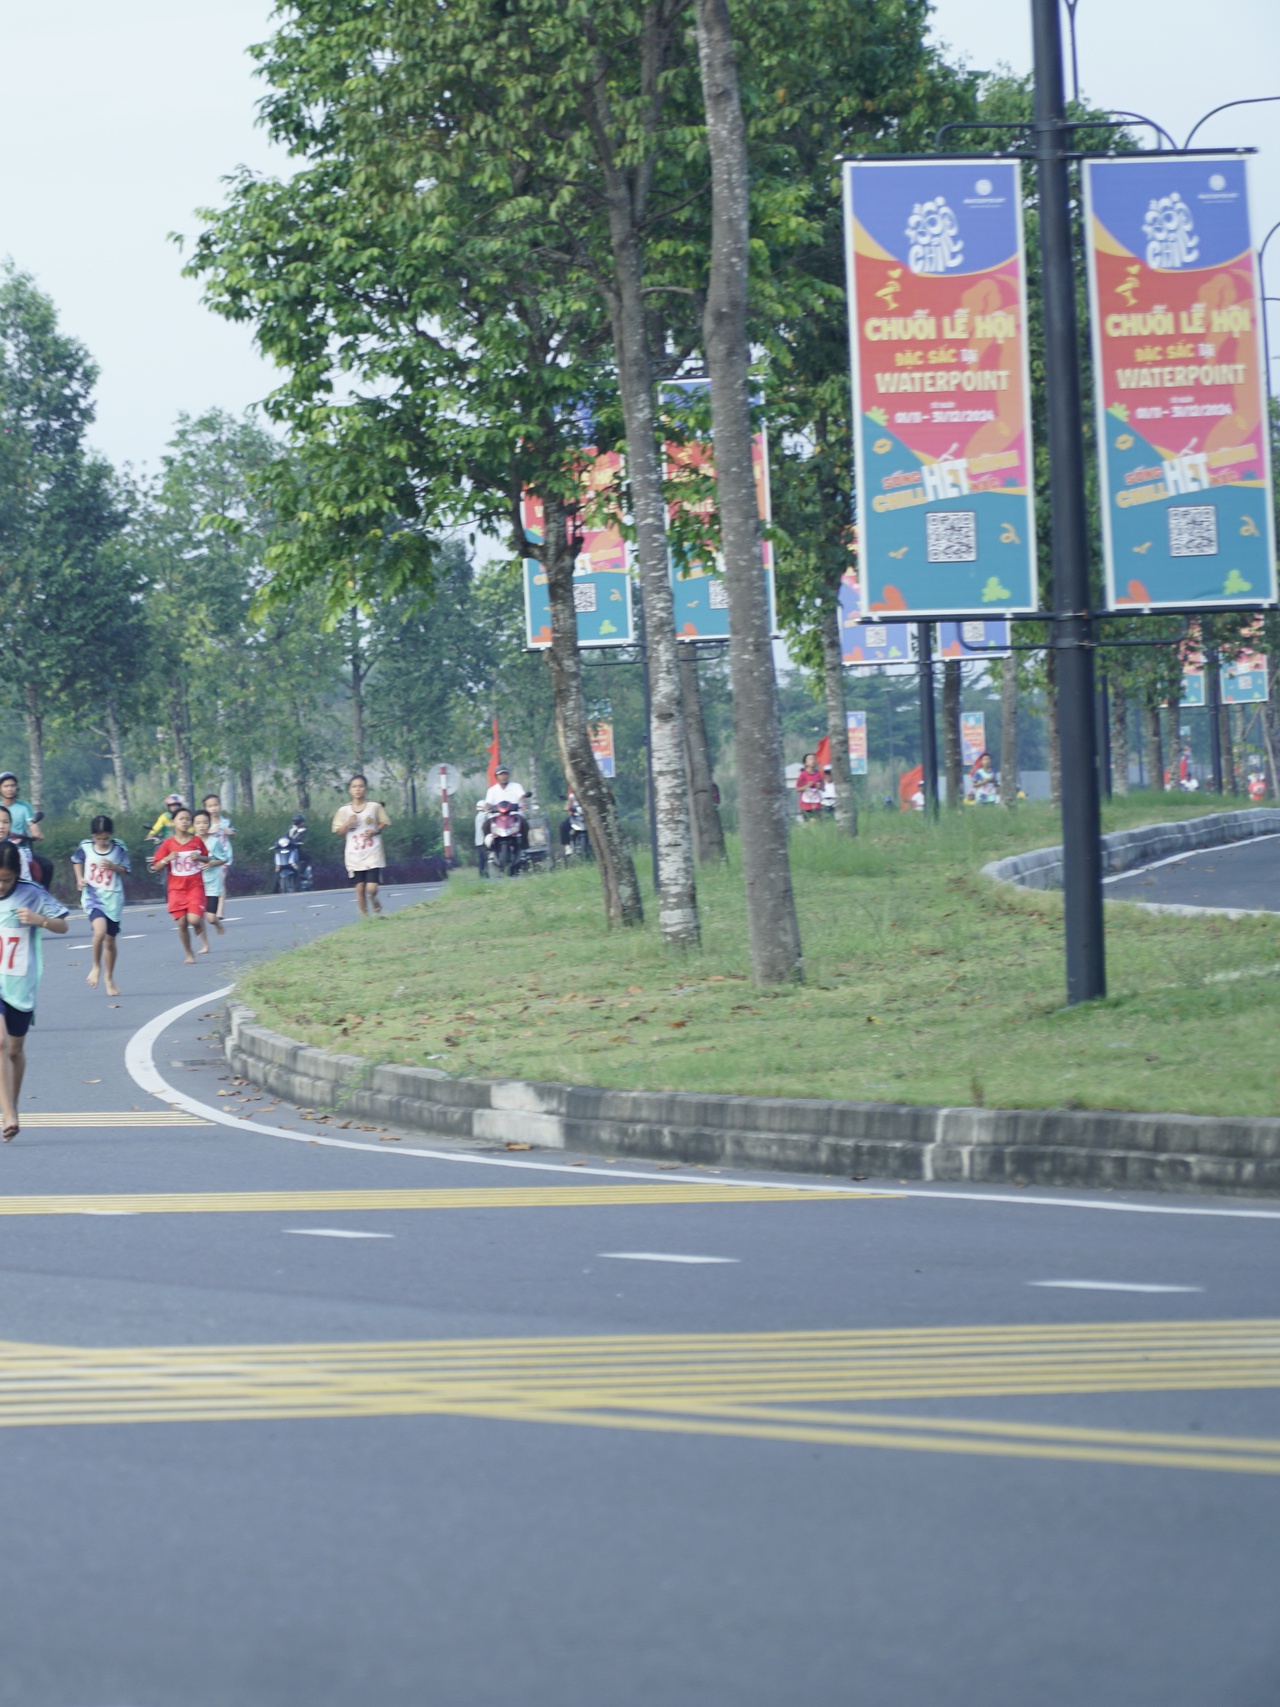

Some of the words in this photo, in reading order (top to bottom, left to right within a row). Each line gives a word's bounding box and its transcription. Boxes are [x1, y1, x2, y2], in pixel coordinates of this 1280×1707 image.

[864, 309, 936, 341] CHUỖI
[942, 308, 970, 339] LỄ
[974, 310, 1016, 344] HỘI
[1105, 304, 1175, 337] CHUỖI
[1179, 303, 1206, 334] LỄ
[1211, 305, 1251, 338] HỘI
[927, 344, 958, 364] SẮC
[1166, 339, 1195, 359] SẮC
[875, 370, 1010, 393] WATERPOINT
[1115, 364, 1247, 389] WATERPOINT
[921, 442, 970, 502] HẾT
[1161, 436, 1210, 497] HẾT
[872, 487, 928, 513] CHILL
[1115, 482, 1169, 508] CHILL
[90, 863, 113, 886] 389
